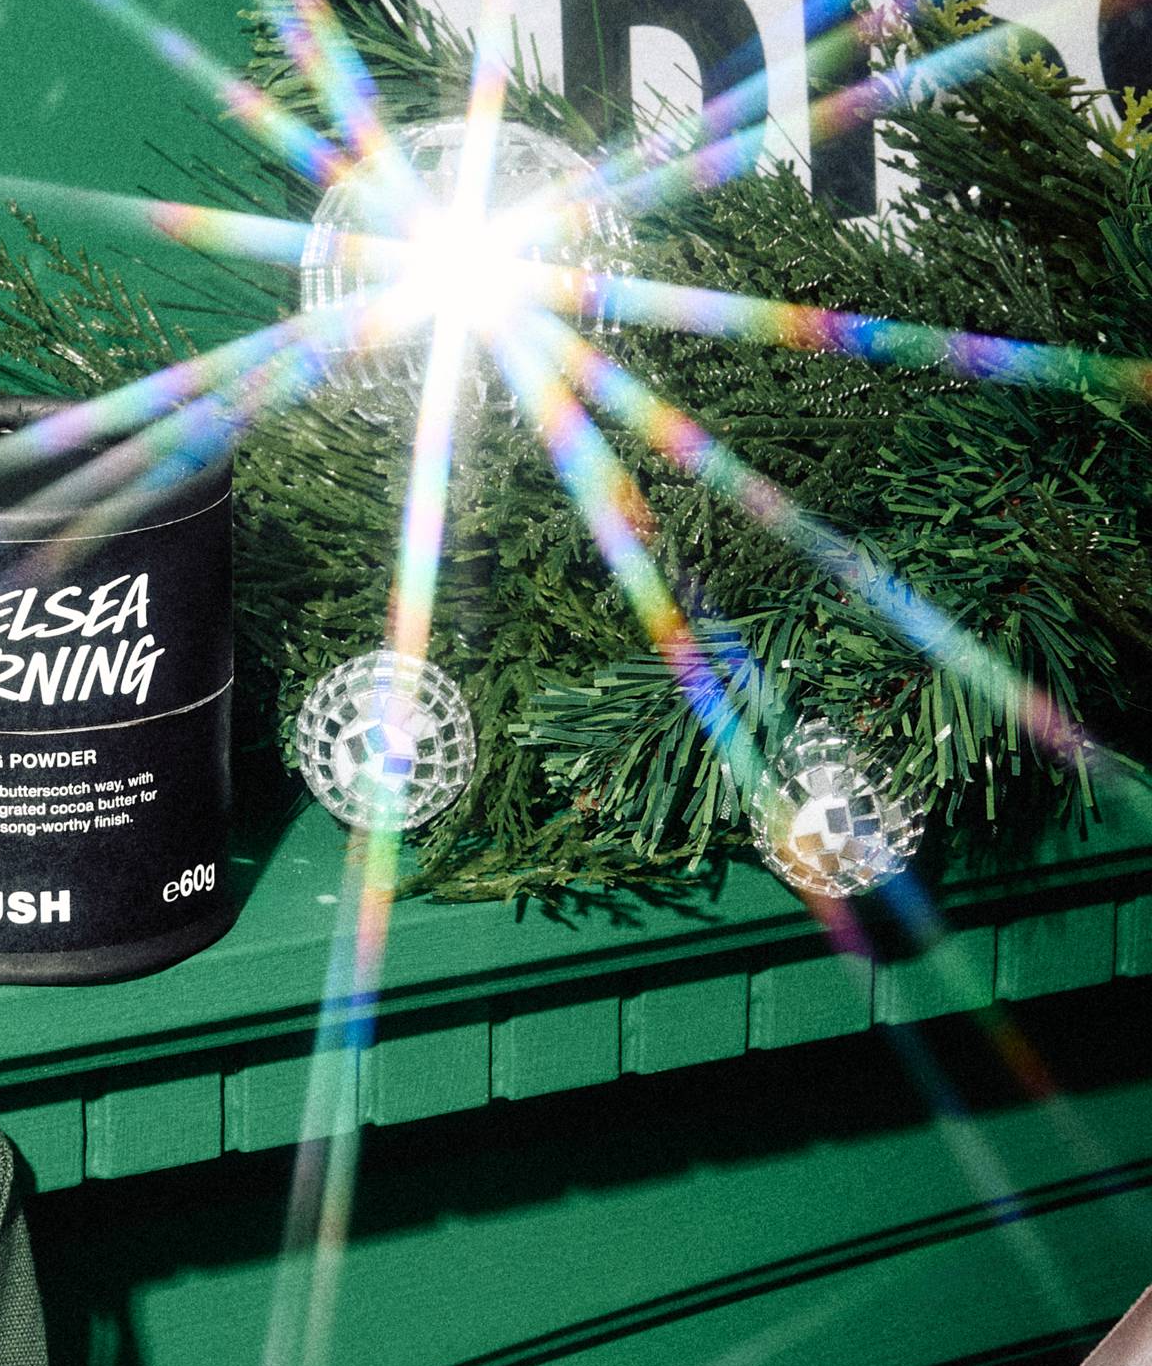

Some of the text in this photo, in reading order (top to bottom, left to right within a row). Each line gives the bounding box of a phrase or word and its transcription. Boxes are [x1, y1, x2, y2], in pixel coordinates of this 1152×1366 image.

[9, 749, 97, 769] POWDER
[0, 781, 90, 797] butterscotch
[95, 780, 124, 792] way,
[128, 771, 154, 787] with
[50, 801, 94, 814] cocoa
[98, 794, 138, 810] butter
[140, 789, 158, 803] for
[0, 819, 91, 836] song-worthy
[94, 812, 134, 828] finish.
